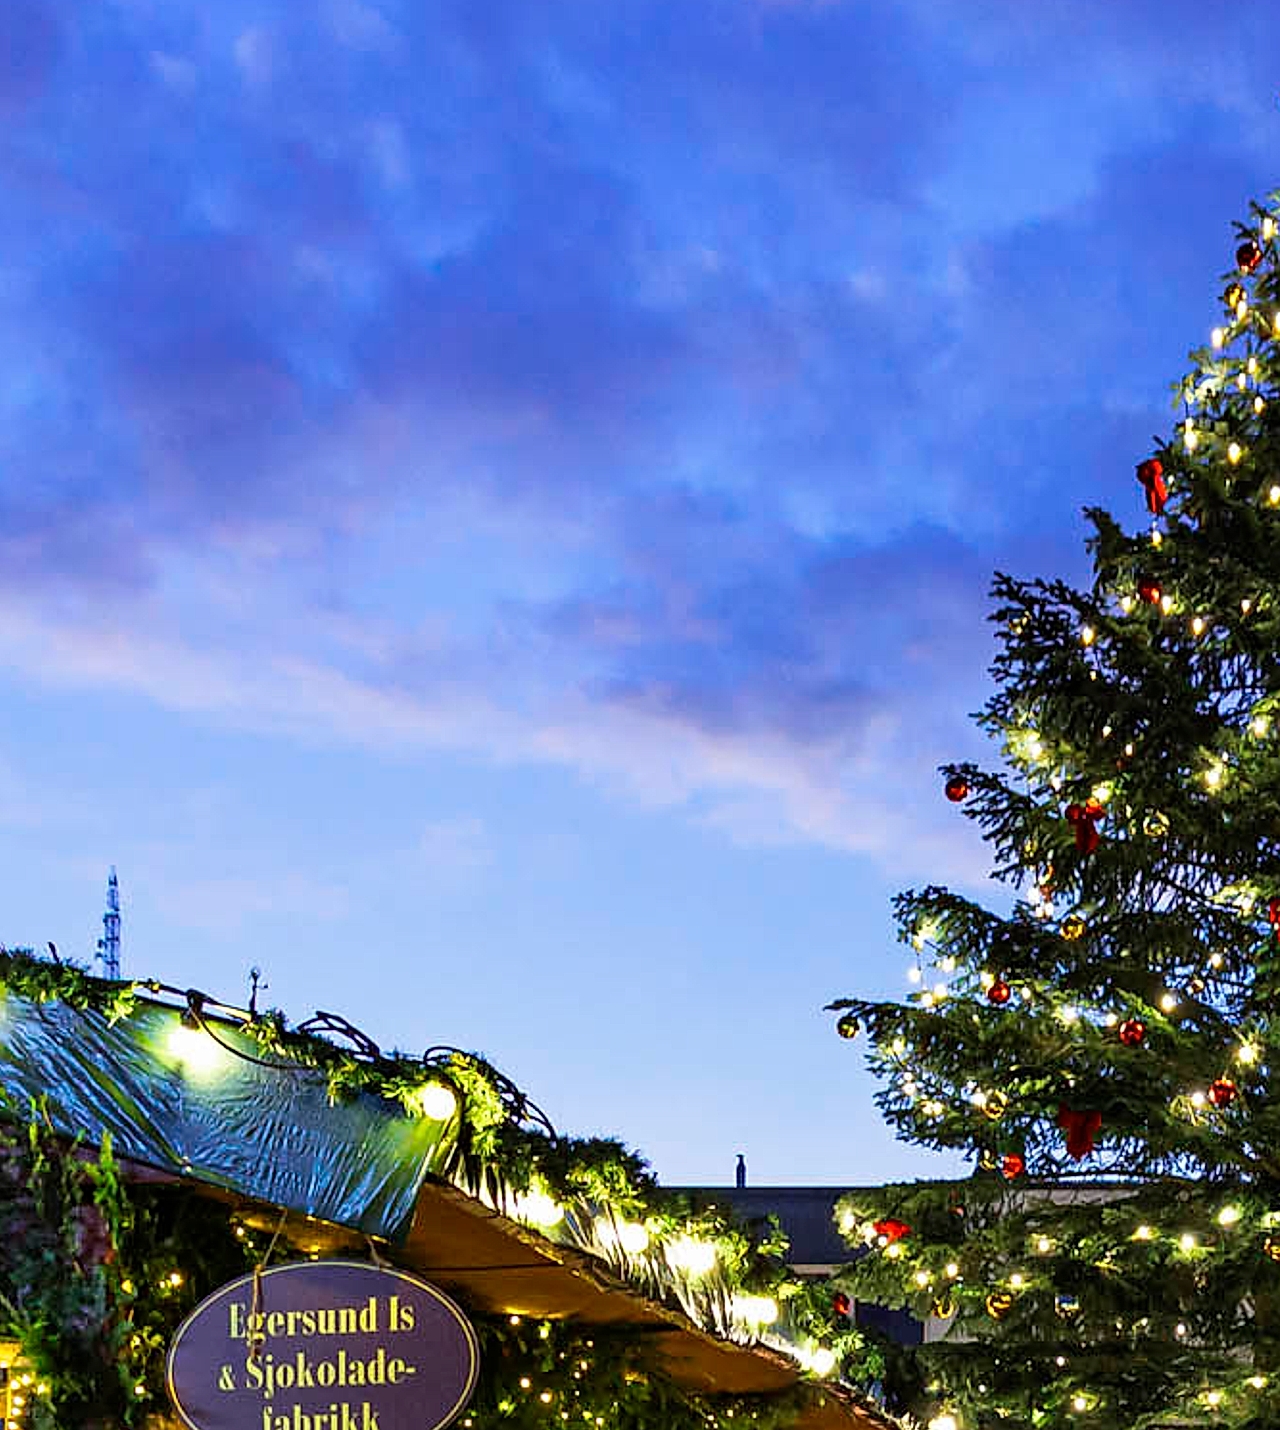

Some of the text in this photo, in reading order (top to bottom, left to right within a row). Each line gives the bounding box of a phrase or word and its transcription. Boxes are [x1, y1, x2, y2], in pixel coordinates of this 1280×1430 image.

[228, 1295, 415, 1347] Egersund Is
[218, 1348, 417, 1399] & Sjokolade-
